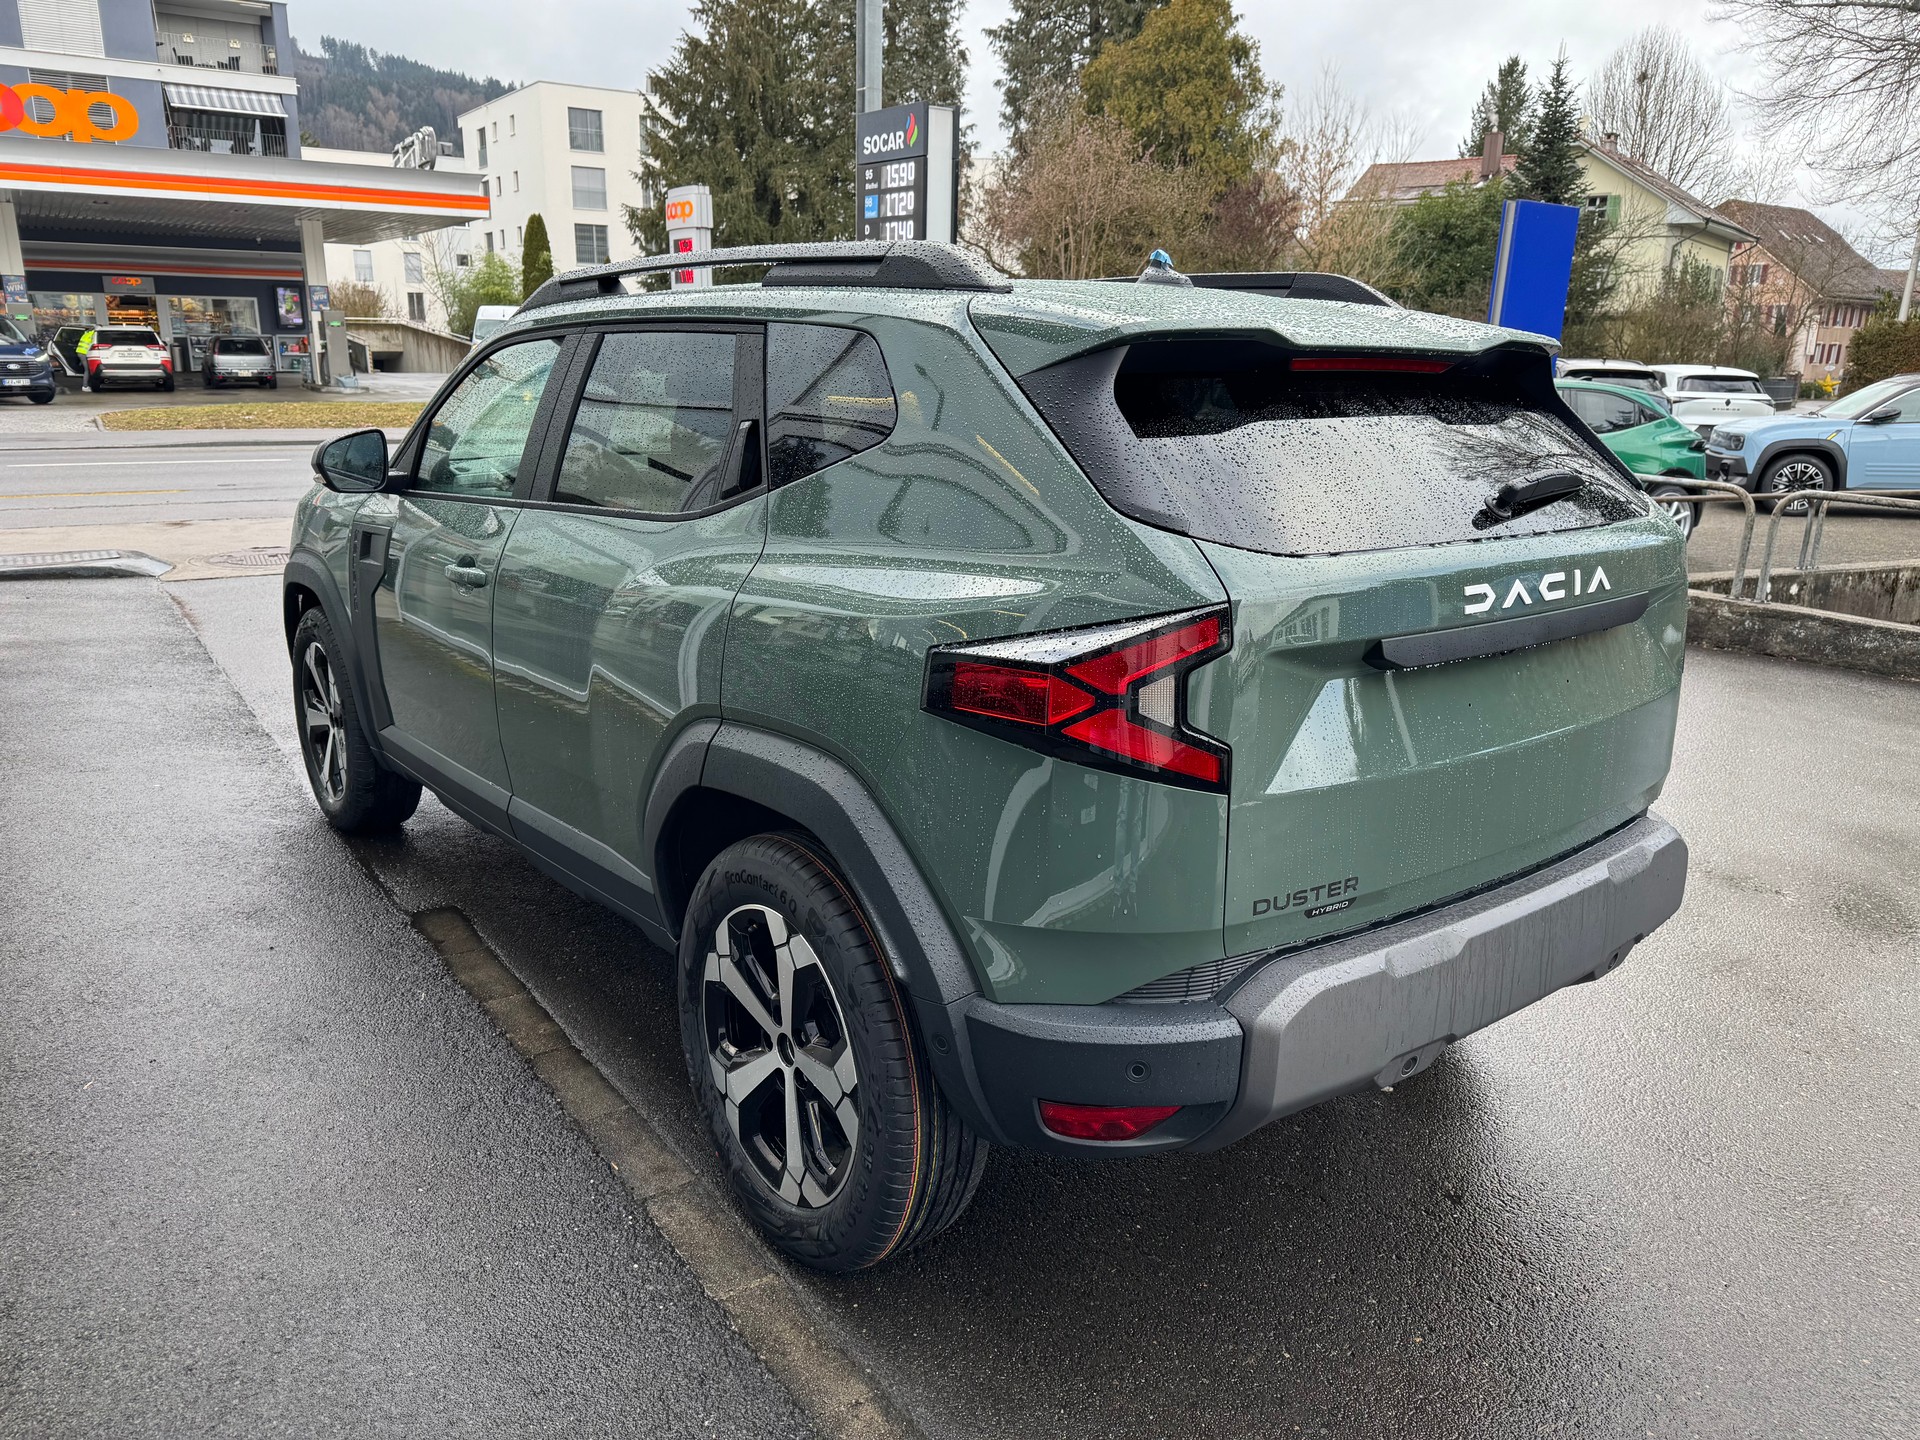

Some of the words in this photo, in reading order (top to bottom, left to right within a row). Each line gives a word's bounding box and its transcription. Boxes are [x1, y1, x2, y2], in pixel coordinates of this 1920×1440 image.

[863, 130, 905, 155] SOCAR
[667, 200, 694, 224] coop
[865, 224, 870, 235] D
[112, 277, 142, 287] coop
[1463, 566, 1611, 615] DACIA
[725, 869, 778, 898] EcoContact
[780, 890, 788, 904] 6
[1252, 876, 1360, 917] DUSTER
[1311, 900, 1349, 917] HYBRID
